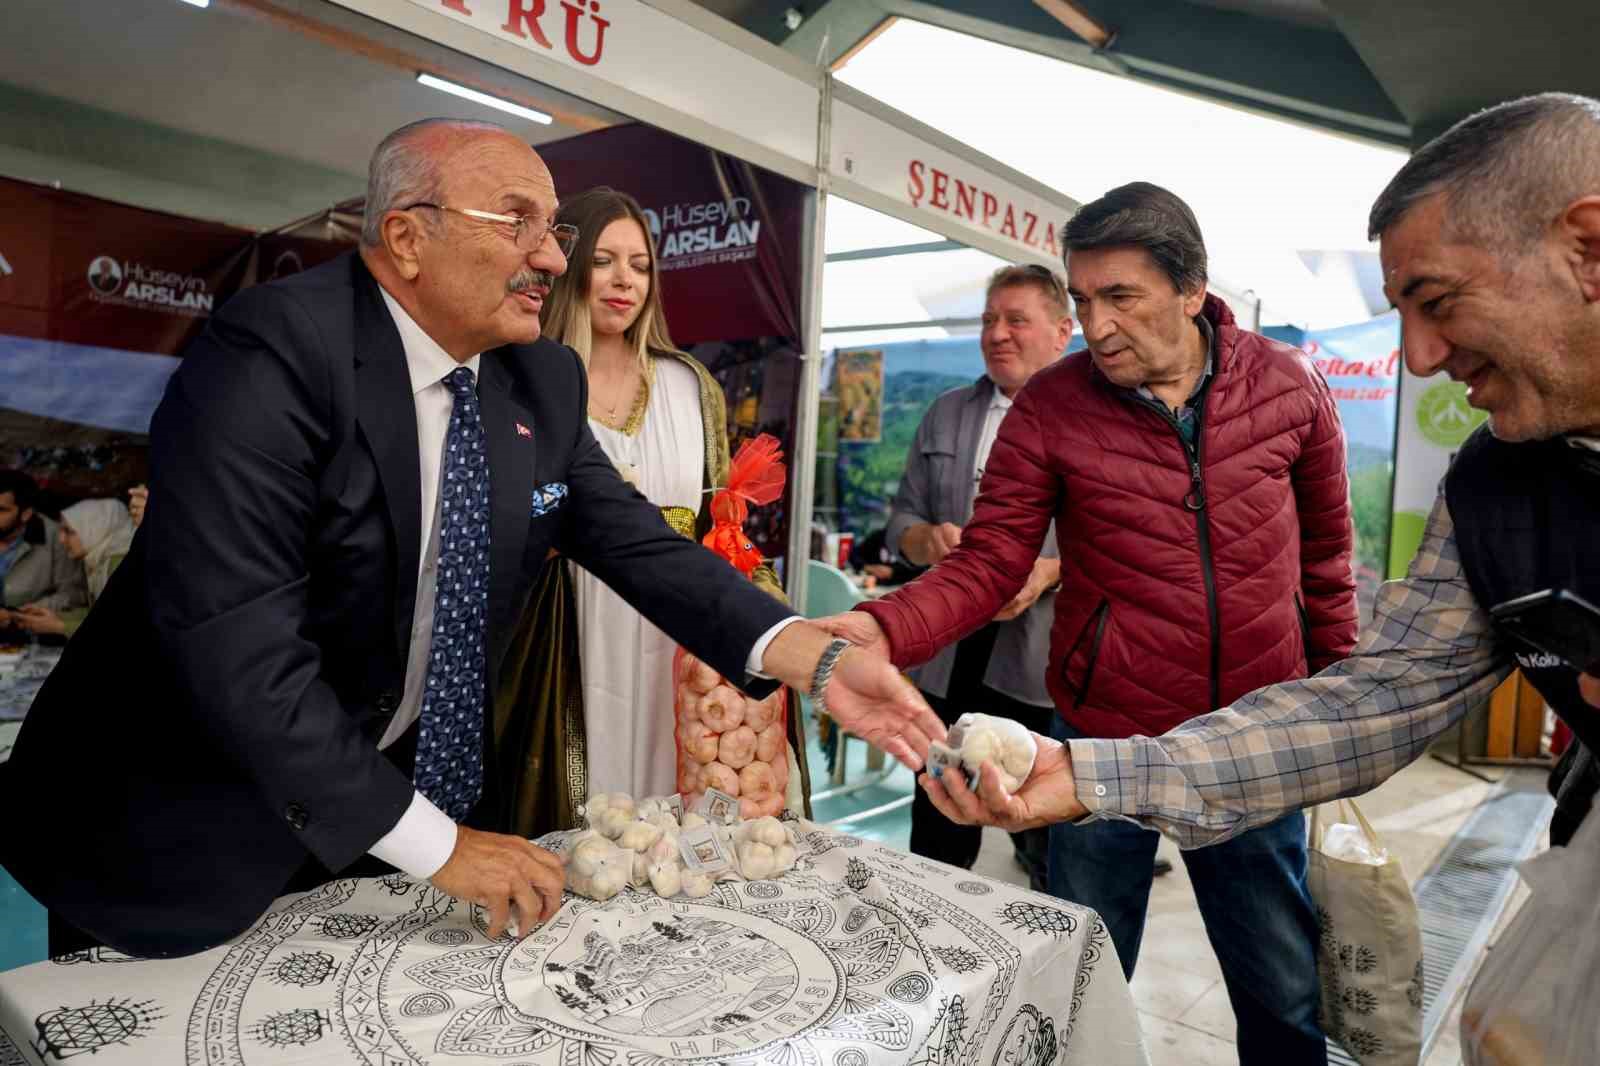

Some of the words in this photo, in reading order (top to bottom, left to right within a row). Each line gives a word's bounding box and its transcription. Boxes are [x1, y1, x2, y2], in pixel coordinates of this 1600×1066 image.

[440, 0, 610, 66] RÜ
[907, 159, 1059, 257] ŞENPAZA
[662, 219, 760, 258] ARSLAN
[124, 280, 214, 311] ARSLAN
